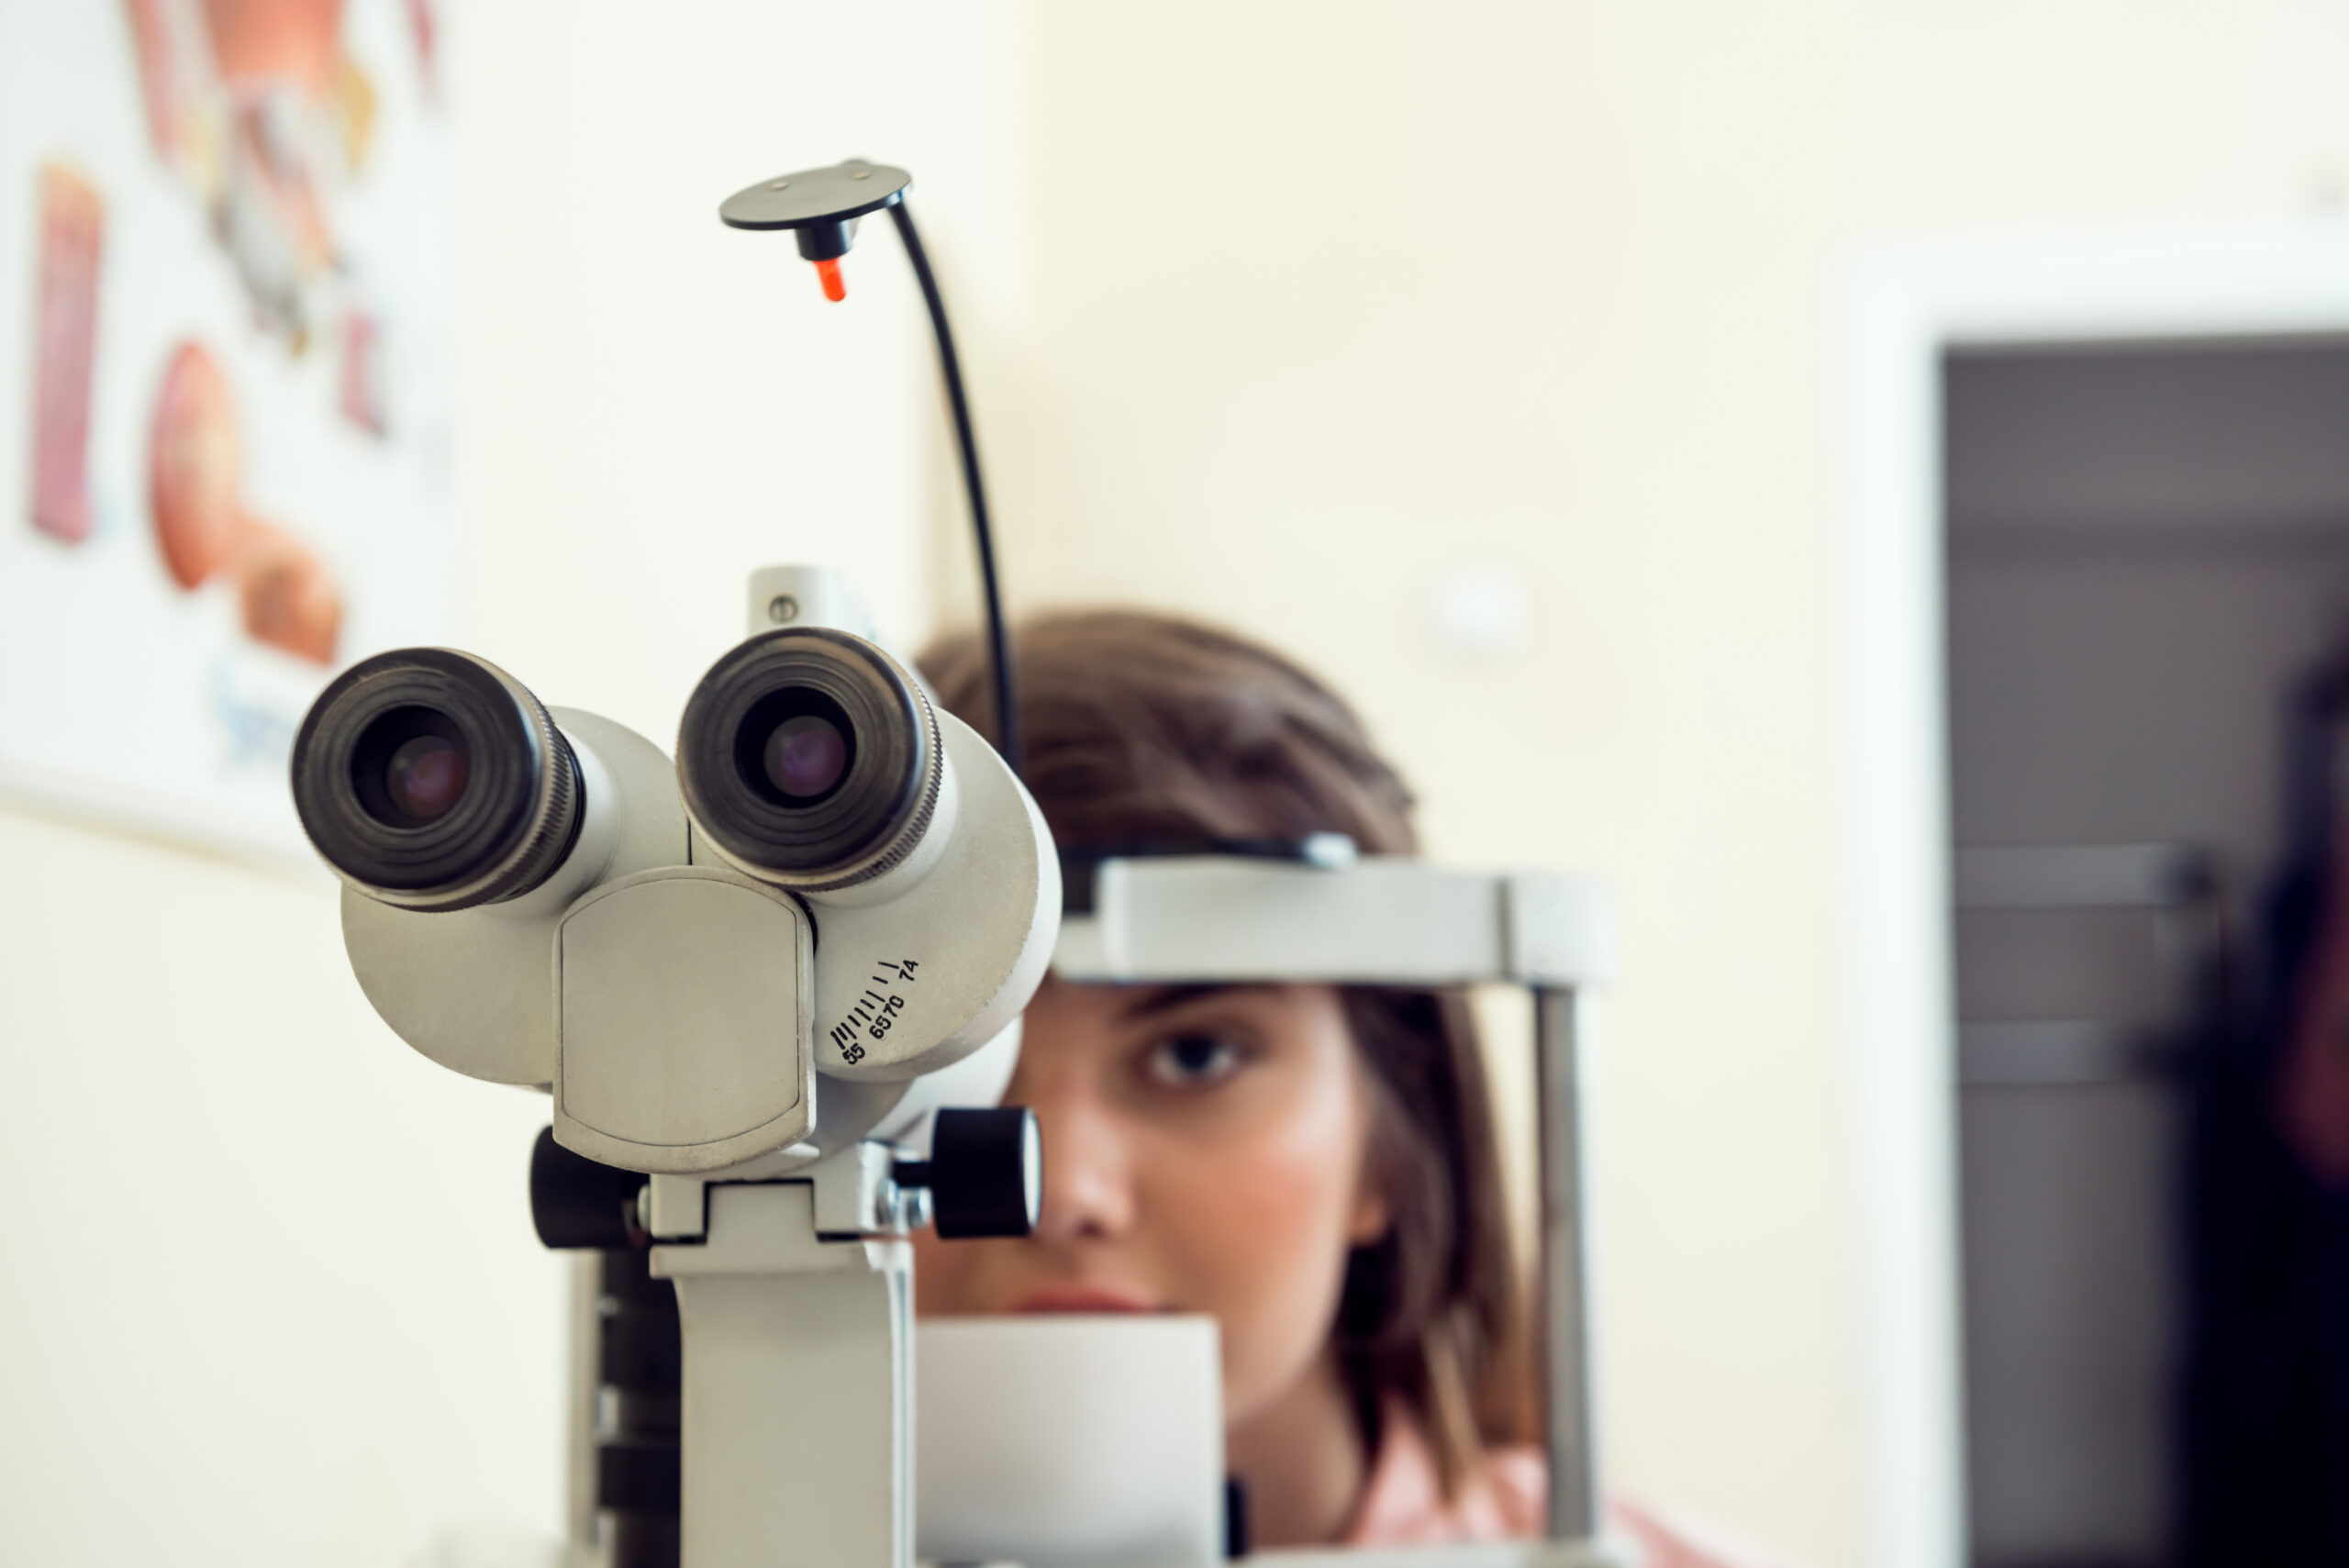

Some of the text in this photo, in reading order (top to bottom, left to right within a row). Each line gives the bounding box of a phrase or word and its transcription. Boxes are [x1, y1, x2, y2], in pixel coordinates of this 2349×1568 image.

[842, 960, 919, 1065] 55 65 70 74
